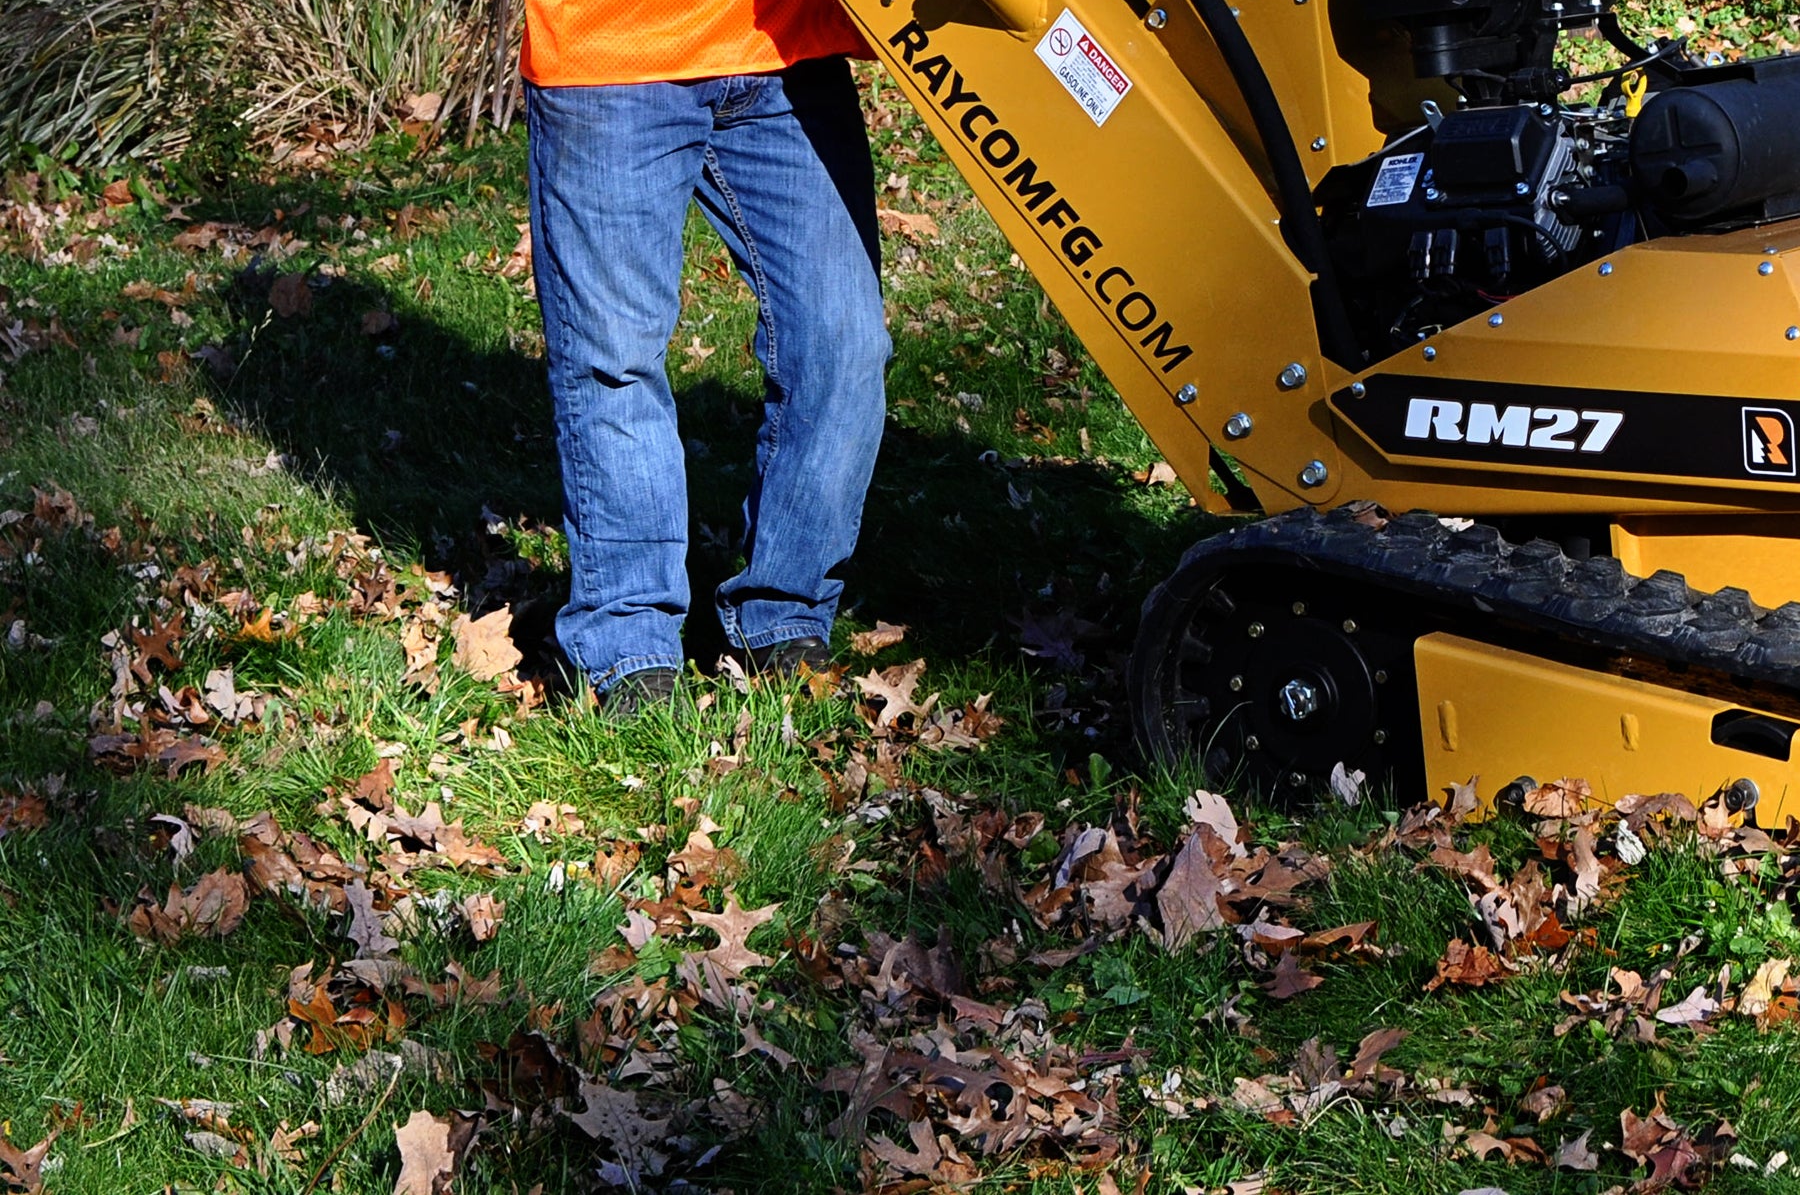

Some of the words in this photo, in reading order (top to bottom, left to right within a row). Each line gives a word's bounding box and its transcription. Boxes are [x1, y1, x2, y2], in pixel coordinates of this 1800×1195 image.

[1059, 66, 1090, 102] GASOLINE
[1086, 97, 1105, 119] ONLY
[1088, 49, 1126, 92] DANGER
[888, 20, 1193, 374] RAYCOMFG.COM
[1404, 397, 1624, 453] RM27
